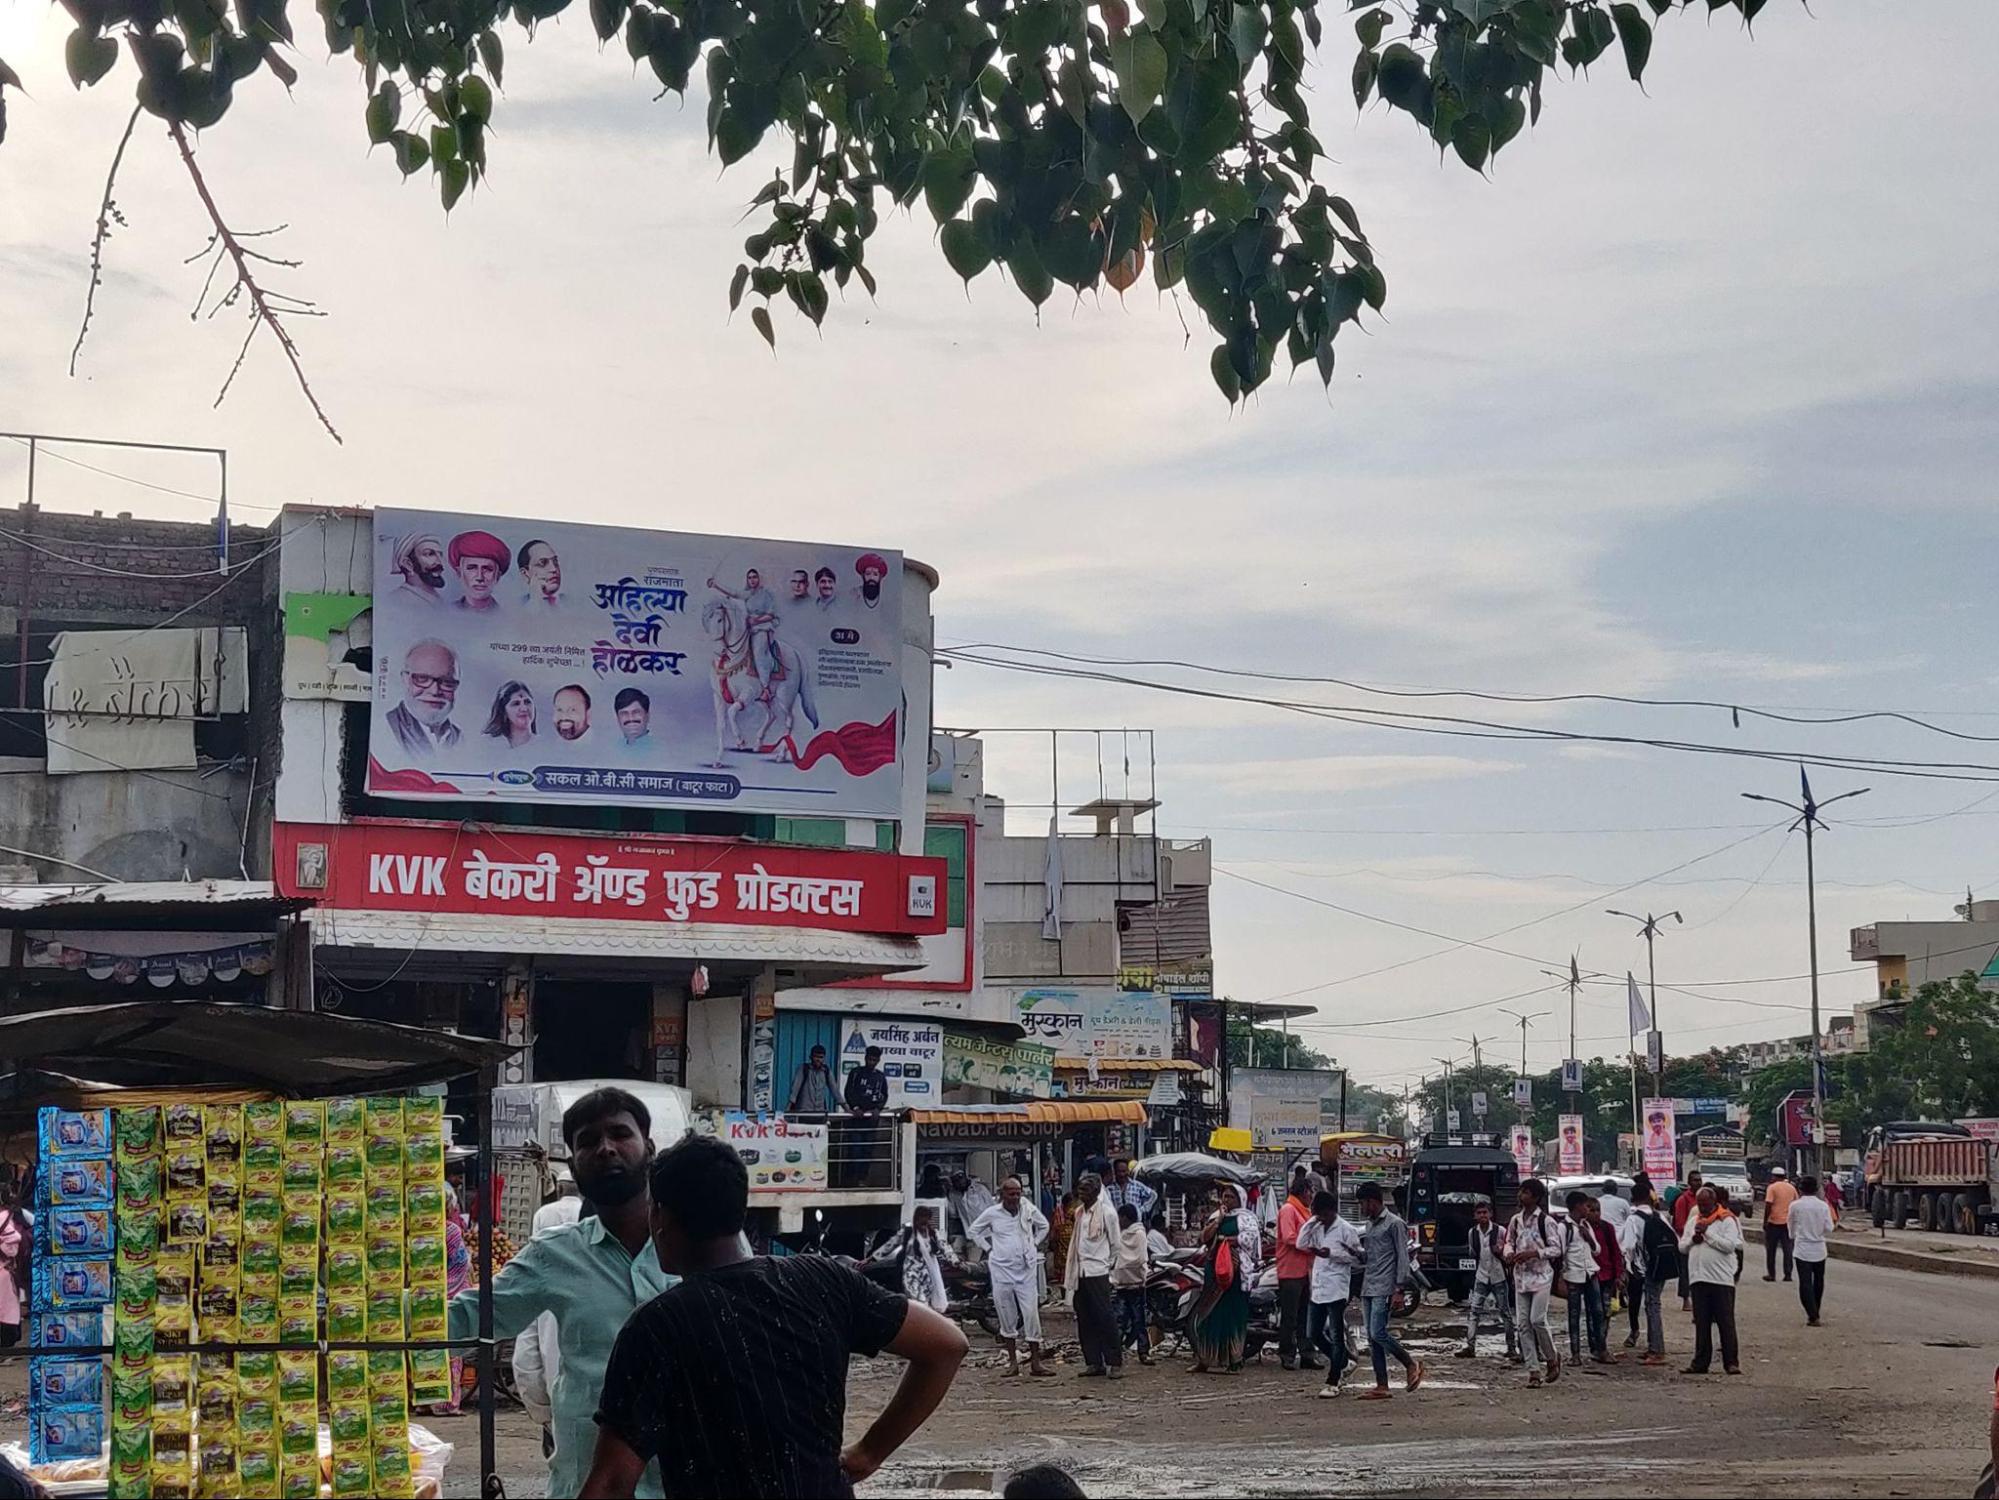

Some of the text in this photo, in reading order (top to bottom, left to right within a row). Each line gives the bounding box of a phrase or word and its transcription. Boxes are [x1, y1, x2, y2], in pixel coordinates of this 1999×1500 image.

[643, 575, 684, 588] राजमाता
[589, 577, 688, 615] अहिल्या
[609, 613, 670, 648] देवी
[511, 643, 528, 652] 299
[590, 640, 688, 679] होळकर
[546, 772, 582, 787] सकल
[583, 770, 636, 789] ओ.बी.सी
[637, 774, 673, 790] समाज
[369, 853, 448, 897] KVK
[462, 849, 561, 902] बेकरी
[663, 871, 722, 920] फुड
[733, 863, 864, 917] प्रोडक्टस
[870, 1025, 940, 1045] जयसिंह अर्बन
[1021, 1012, 1084, 1040] मुस्कान
[880, 1046, 907, 1057] ाखा
[944, 1035, 973, 1050] त्यम
[1017, 1043, 1055, 1066] पार्लर
